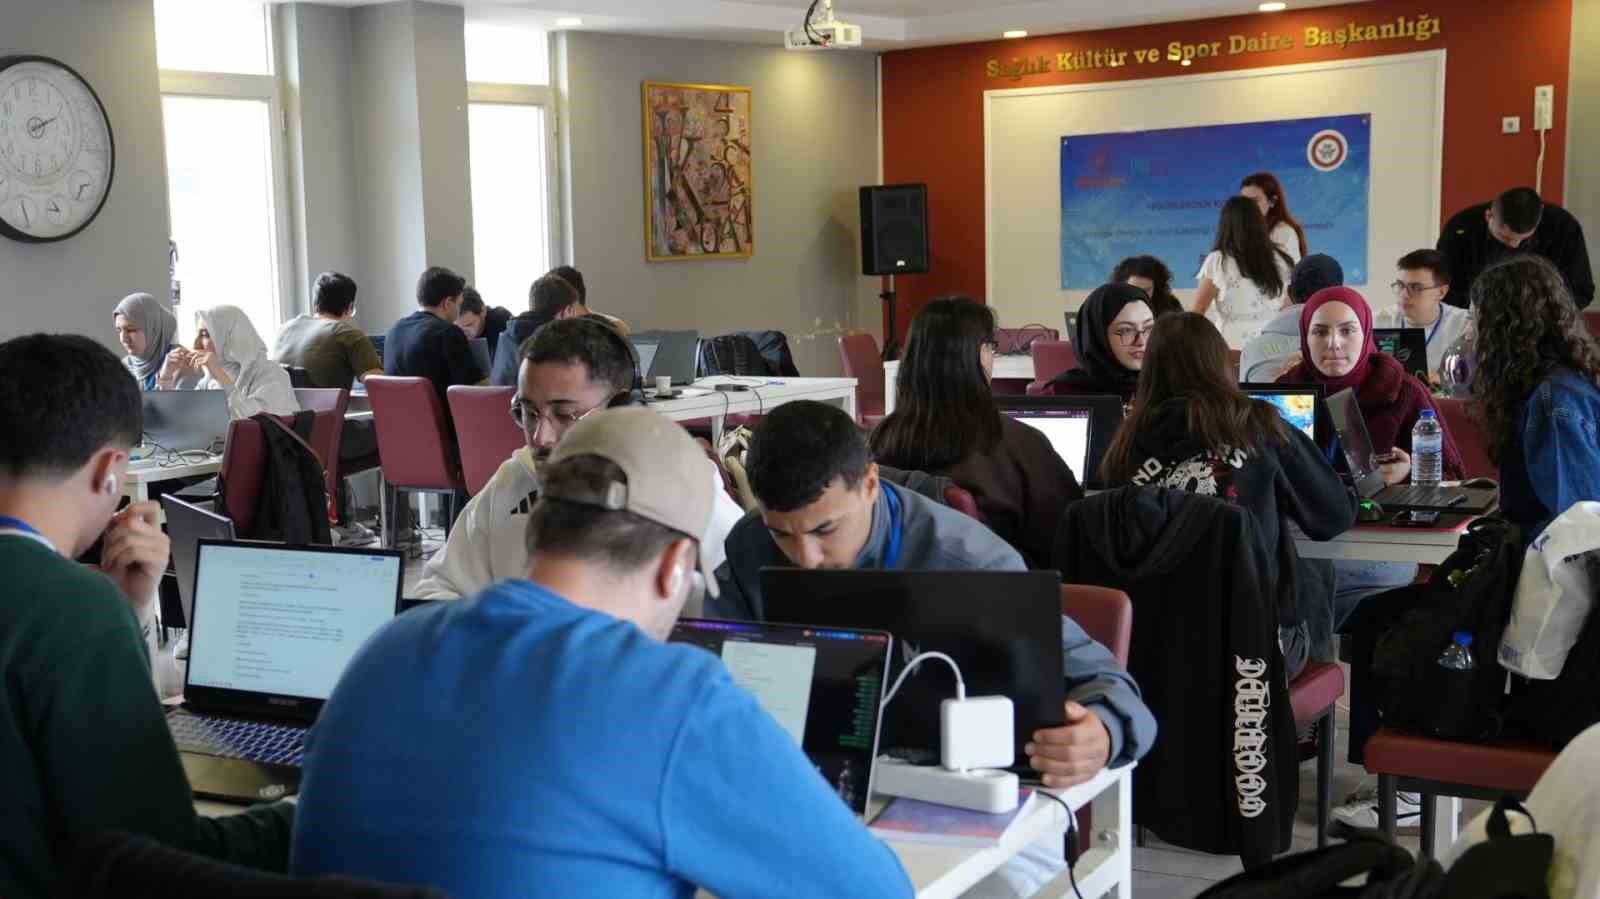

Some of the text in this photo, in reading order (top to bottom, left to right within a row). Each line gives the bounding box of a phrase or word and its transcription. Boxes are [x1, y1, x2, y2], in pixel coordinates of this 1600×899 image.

[1056, 49, 1127, 72] Kültür
[1134, 48, 1159, 64] ve
[1167, 42, 1221, 66] Spor
[1229, 33, 1294, 54] Daire
[1304, 14, 1441, 49] Başkanlığı
